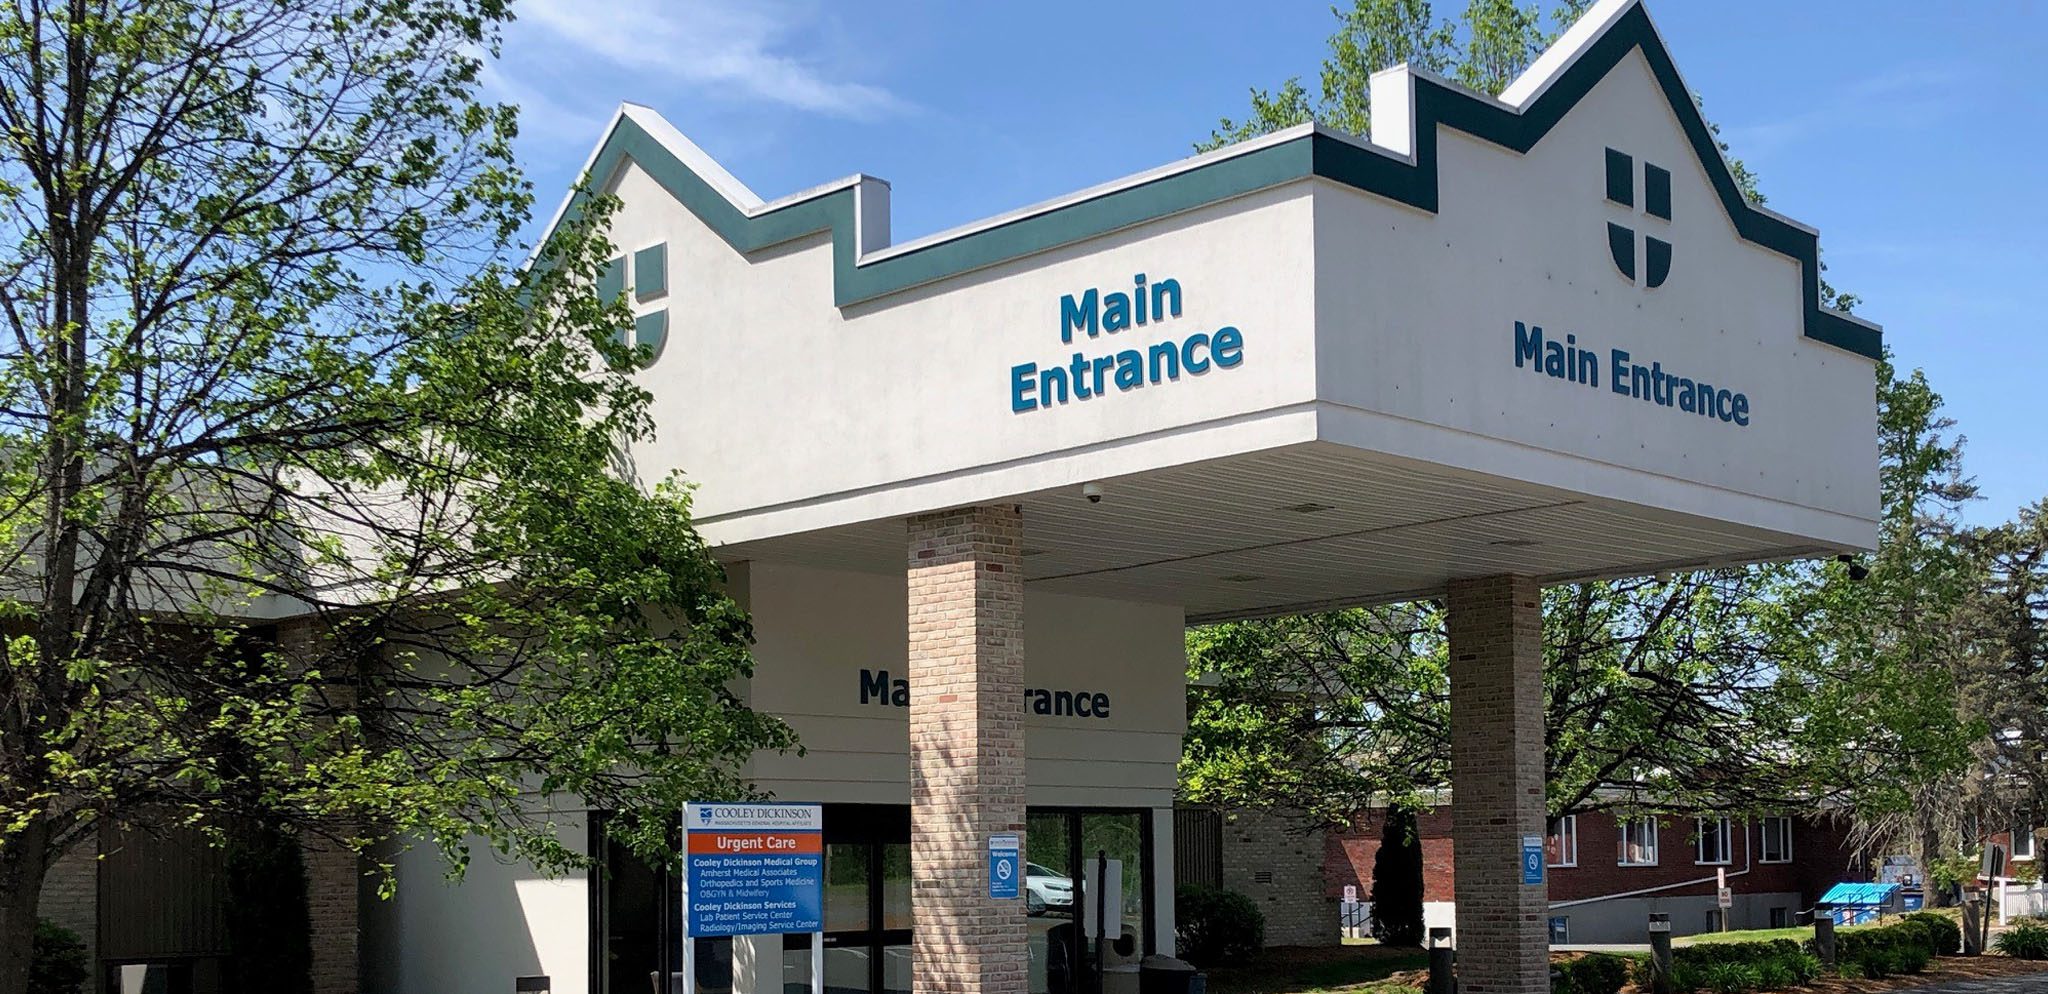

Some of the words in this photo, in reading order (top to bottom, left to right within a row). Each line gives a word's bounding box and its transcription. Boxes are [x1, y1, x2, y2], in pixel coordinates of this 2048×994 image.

[1060, 273, 1182, 345] Main
[1011, 326, 1244, 415] Entrance
[1514, 320, 1599, 388] Main
[1611, 348, 1749, 427] Entrance
[860, 669, 910, 707] Ma
[1024, 687, 1110, 718] rance
[715, 808, 755, 819] COOLEY
[757, 808, 812, 819] DICKINSON
[717, 836, 763, 852] Urgent
[766, 836, 796, 849] Care
[693, 859, 721, 868] Cooley
[723, 858, 762, 866] Dickinson
[764, 857, 793, 866] Medical
[794, 857, 818, 866] Group
[700, 869, 731, 877] Amherst
[733, 869, 759, 877] Medical
[761, 868, 798, 876] Associates
[700, 879, 743, 889] Orthopedics
[745, 879, 759, 887] and
[761, 878, 783, 887] Sports
[785, 878, 814, 886] Medicine
[736, 889, 769, 898] Midwifery
[694, 903, 721, 912] Cooley
[723, 902, 762, 911] Dickinson
[764, 901, 797, 909] Services
[700, 913, 713, 921] Lab
[715, 912, 740, 920] Patient
[742, 911, 768, 919] Service
[770, 911, 793, 919] Center
[700, 922, 768, 932] Radiology/Imaging
[769, 921, 794, 929] Service
[796, 920, 818, 928] Center
